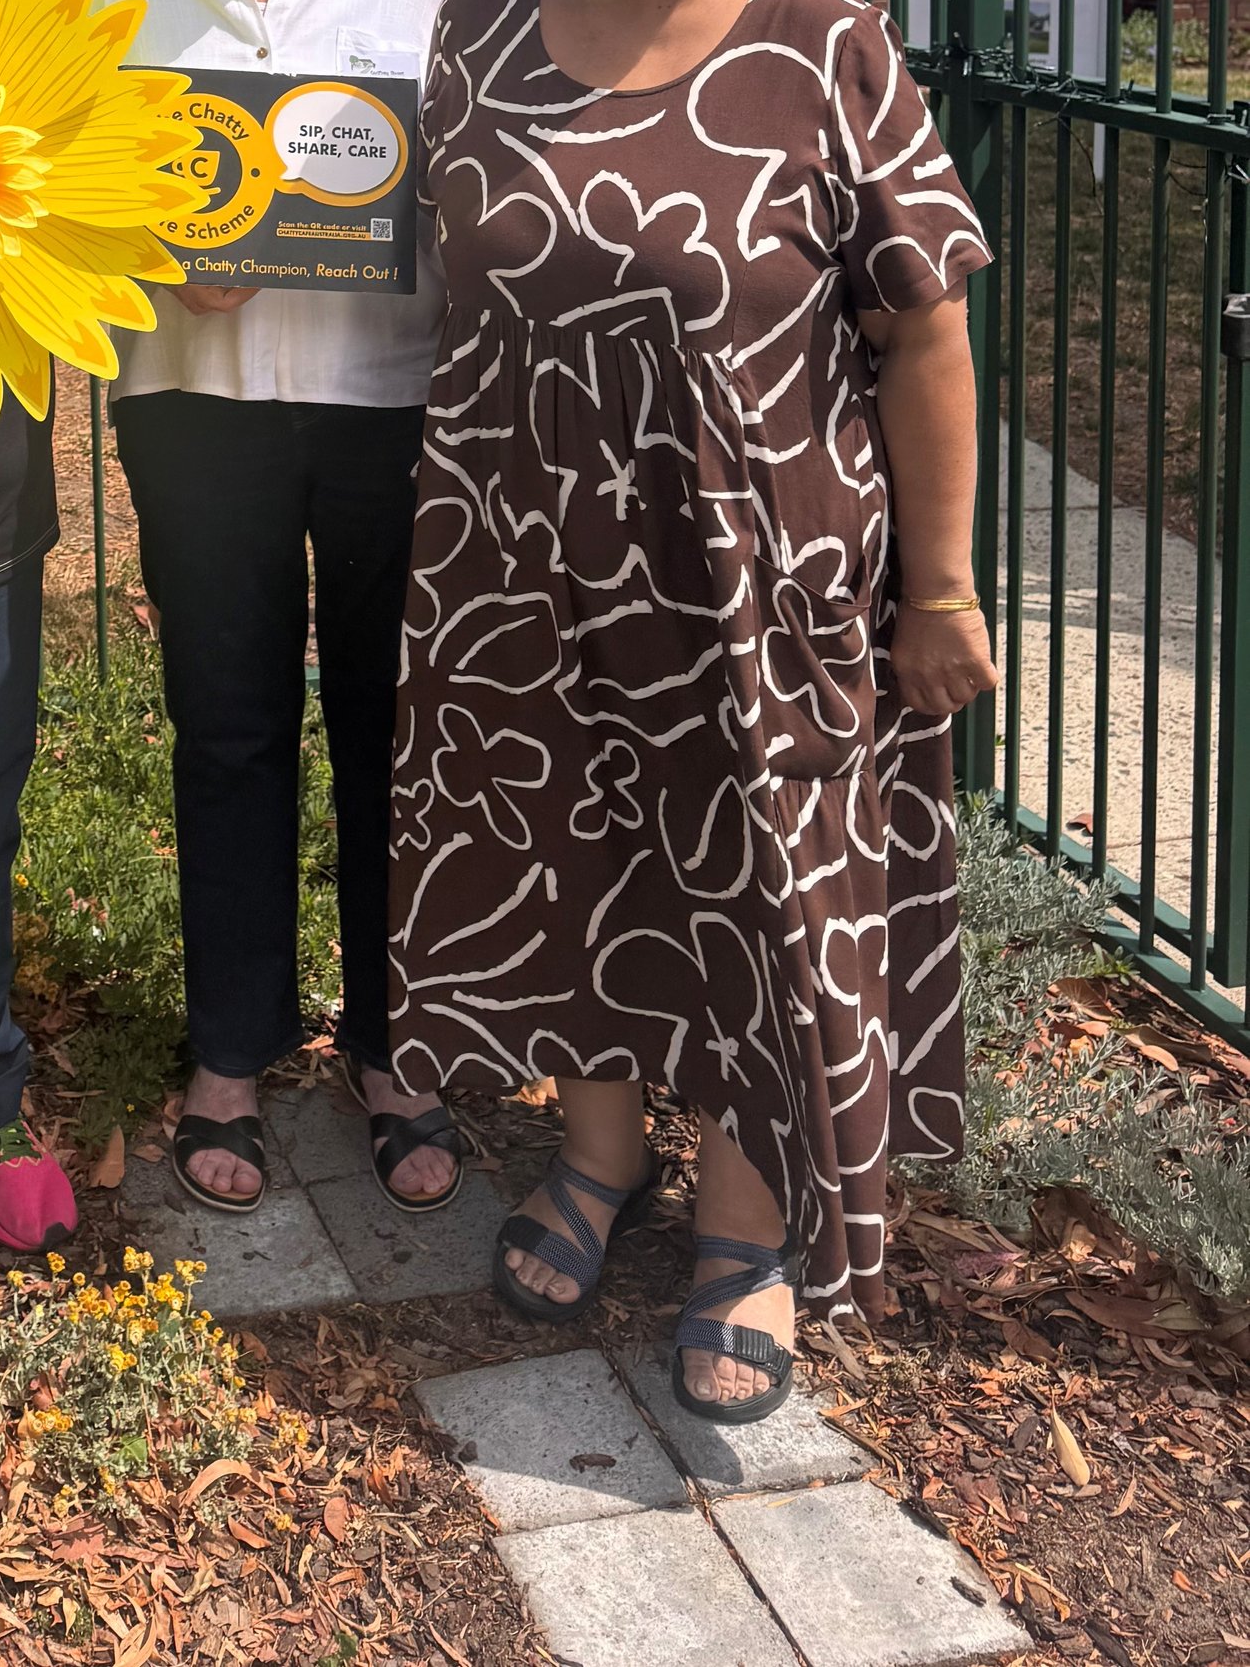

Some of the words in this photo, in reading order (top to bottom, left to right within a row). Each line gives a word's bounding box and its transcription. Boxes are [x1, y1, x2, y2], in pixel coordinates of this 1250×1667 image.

[189, 103, 249, 140] Chatty
[299, 125, 326, 140] SIP,
[332, 127, 375, 143] CHAT,
[288, 142, 342, 158] SHARE,
[348, 145, 387, 158] CARE
[185, 205, 255, 239] Scheme
[182, 261, 191, 270] a
[195, 257, 237, 275] Chatty
[241, 259, 311, 278] Champion,
[316, 263, 357, 278] Reach
[362, 265, 390, 280] Out
